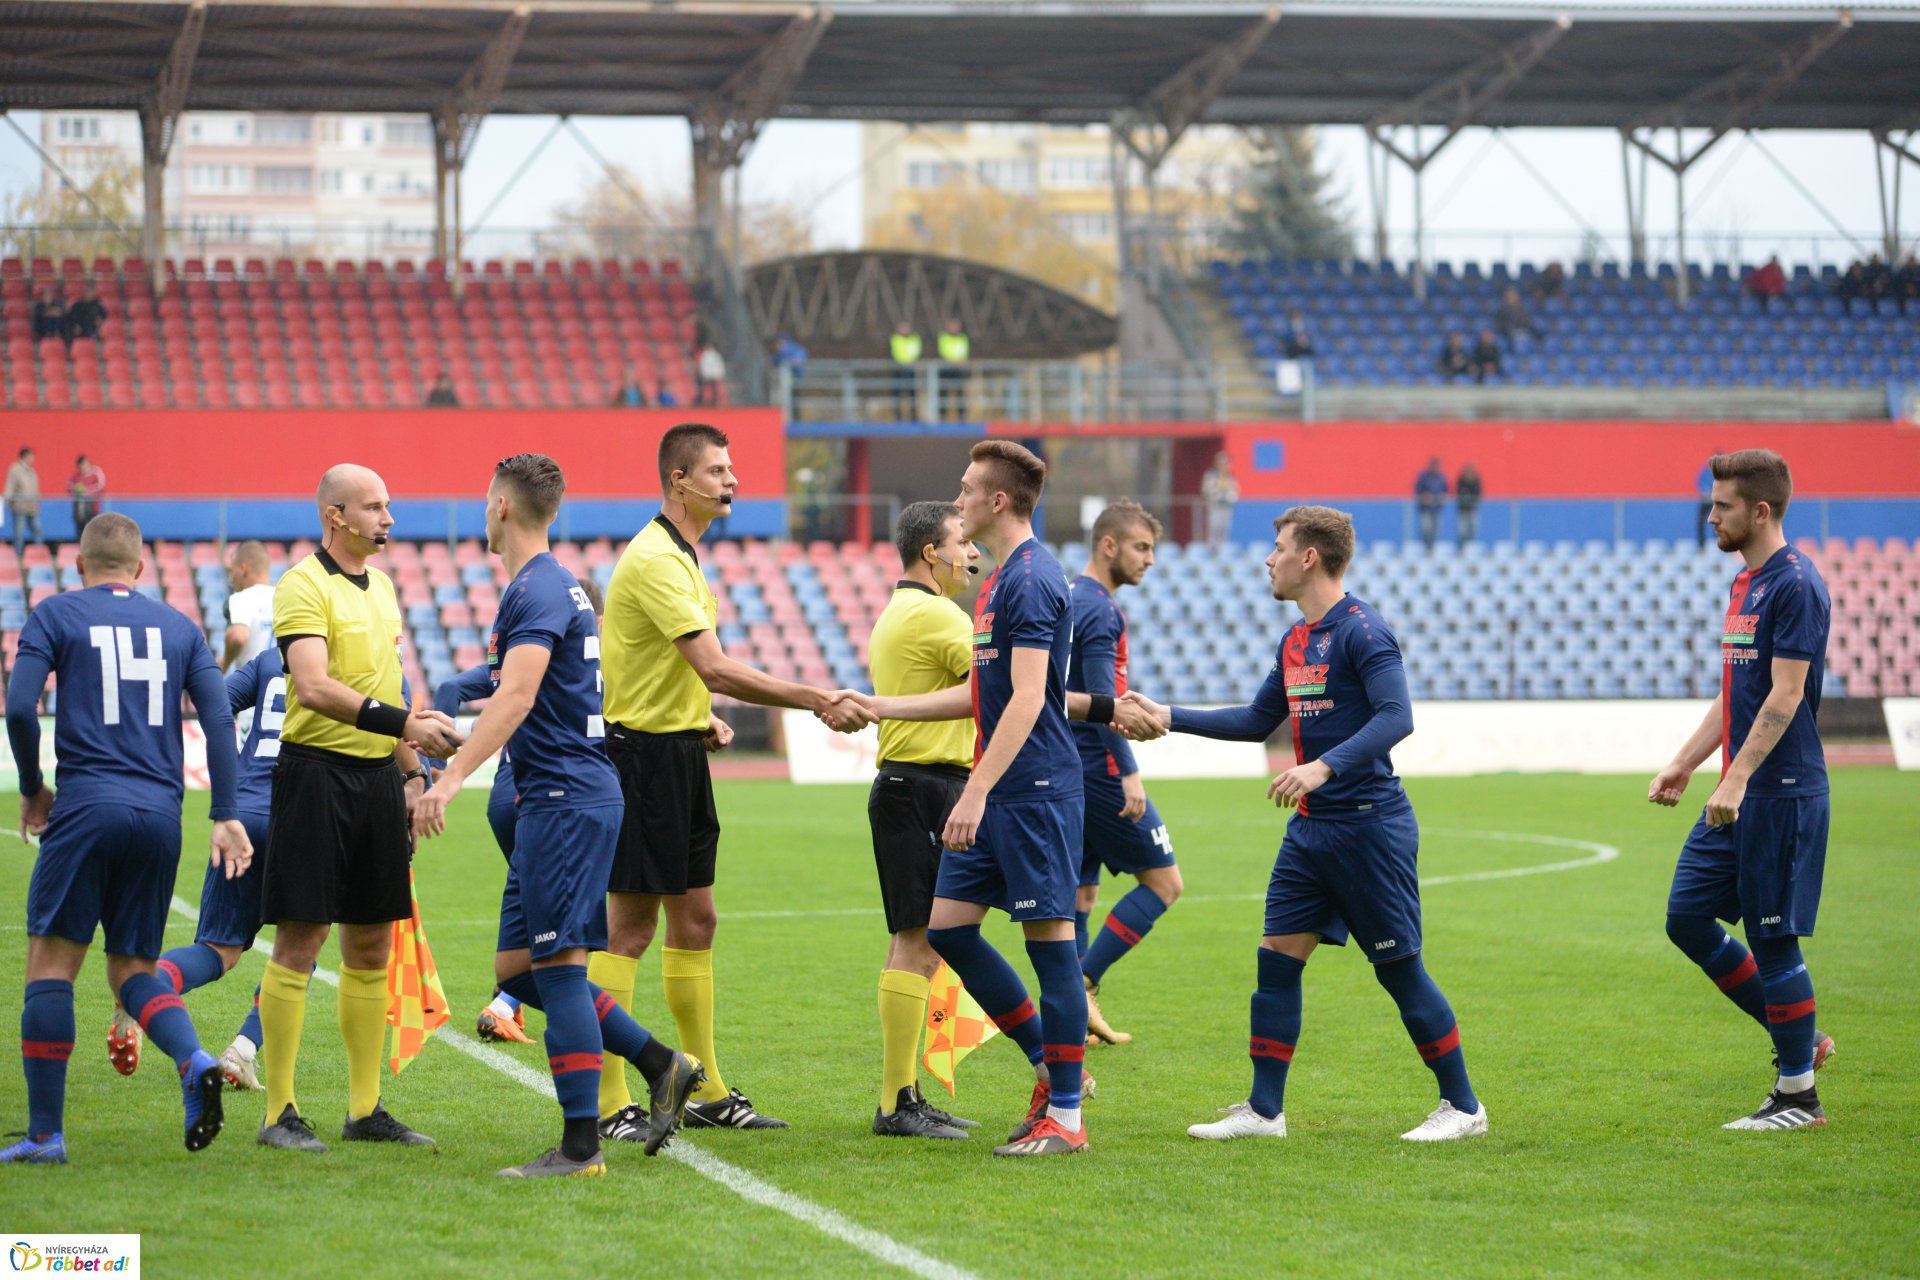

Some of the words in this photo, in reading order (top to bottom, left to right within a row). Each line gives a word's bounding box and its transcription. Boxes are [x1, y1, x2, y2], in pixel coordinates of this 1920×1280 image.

[89, 625, 167, 726] 14
[1014, 899, 1037, 910] JAKO
[1760, 915, 1782, 925] JAKO
[534, 931, 557, 944] JAKO
[1375, 939, 1396, 950] JAKO
